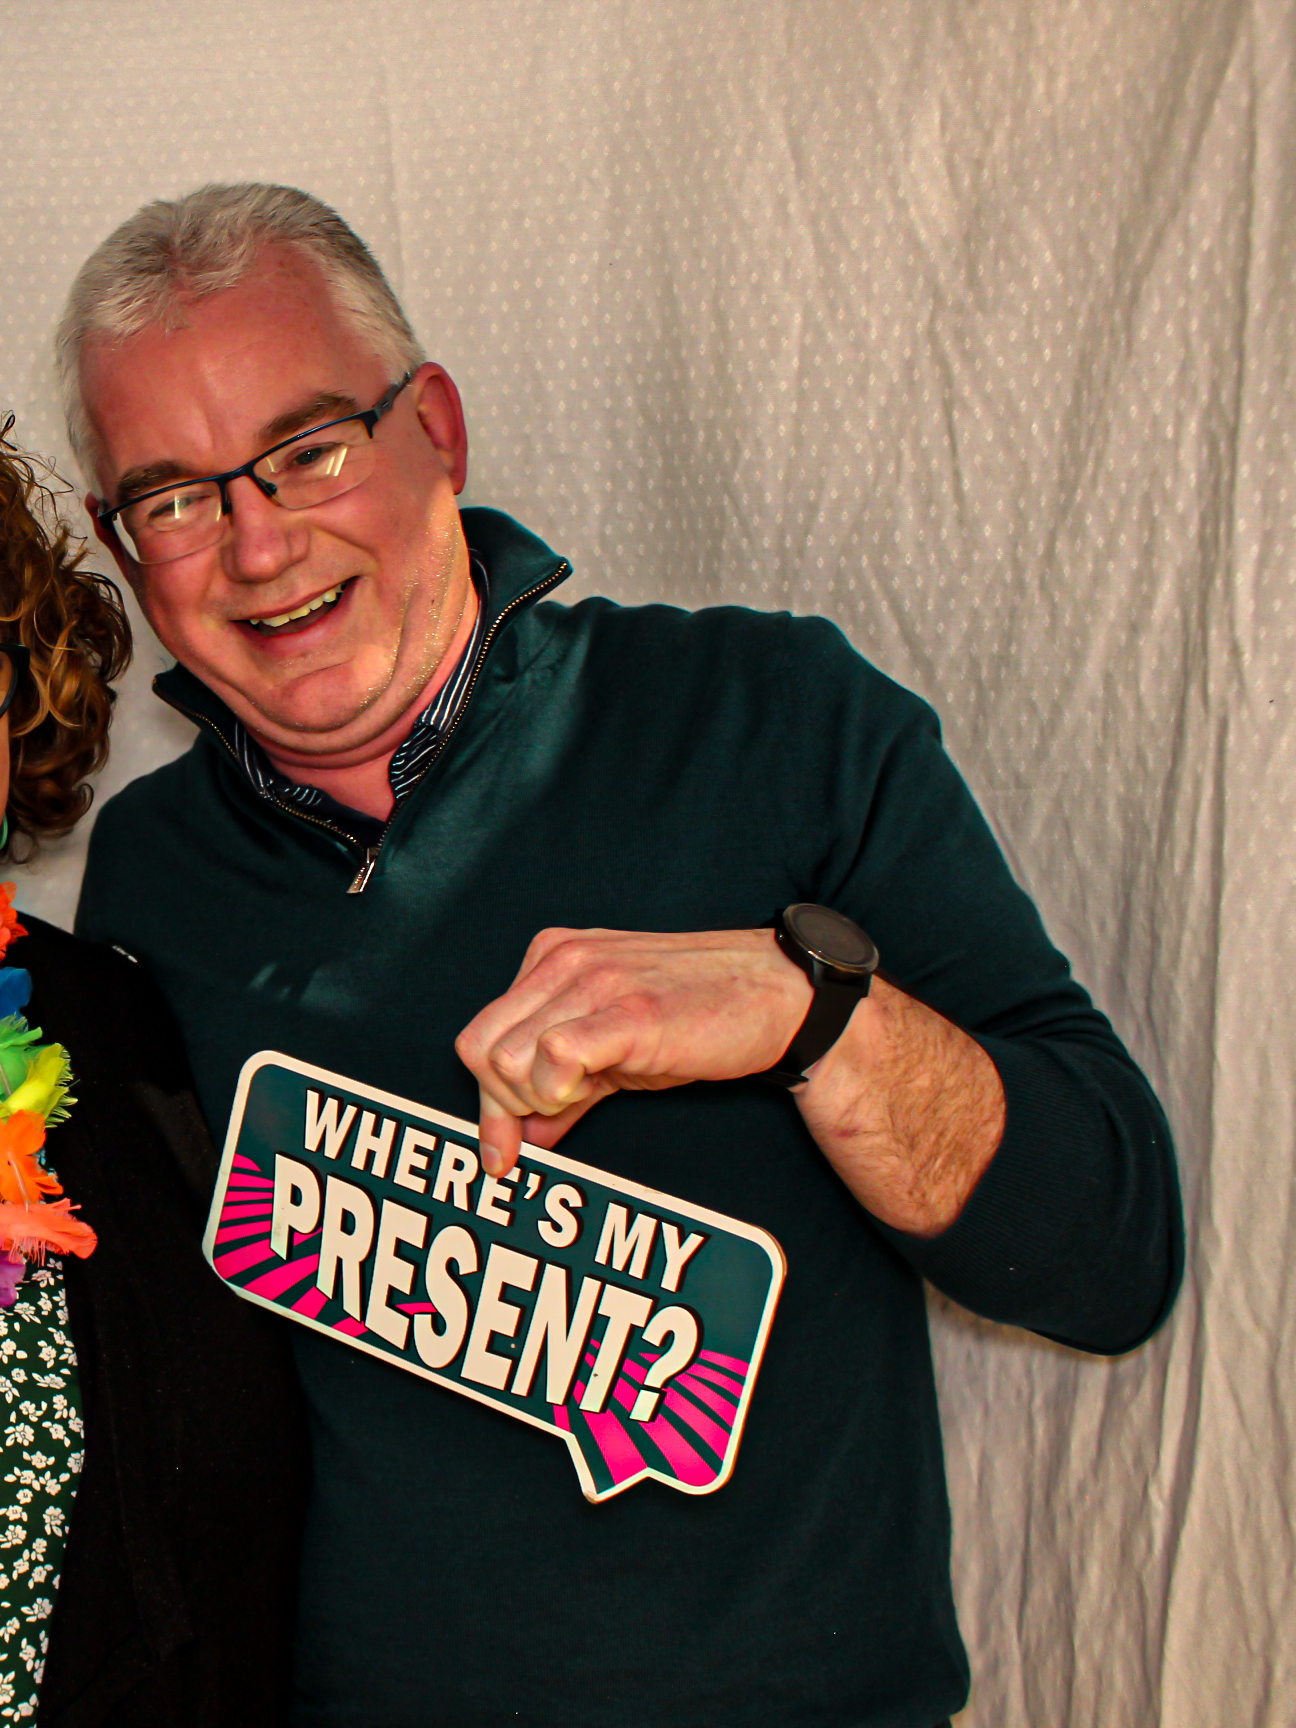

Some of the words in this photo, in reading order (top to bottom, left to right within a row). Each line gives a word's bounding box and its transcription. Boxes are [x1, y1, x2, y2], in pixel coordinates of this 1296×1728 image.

[270, 1153, 700, 1423] PRESENT?
[304, 1089, 586, 1248] WHERE'S
[595, 1202, 705, 1293] MY
